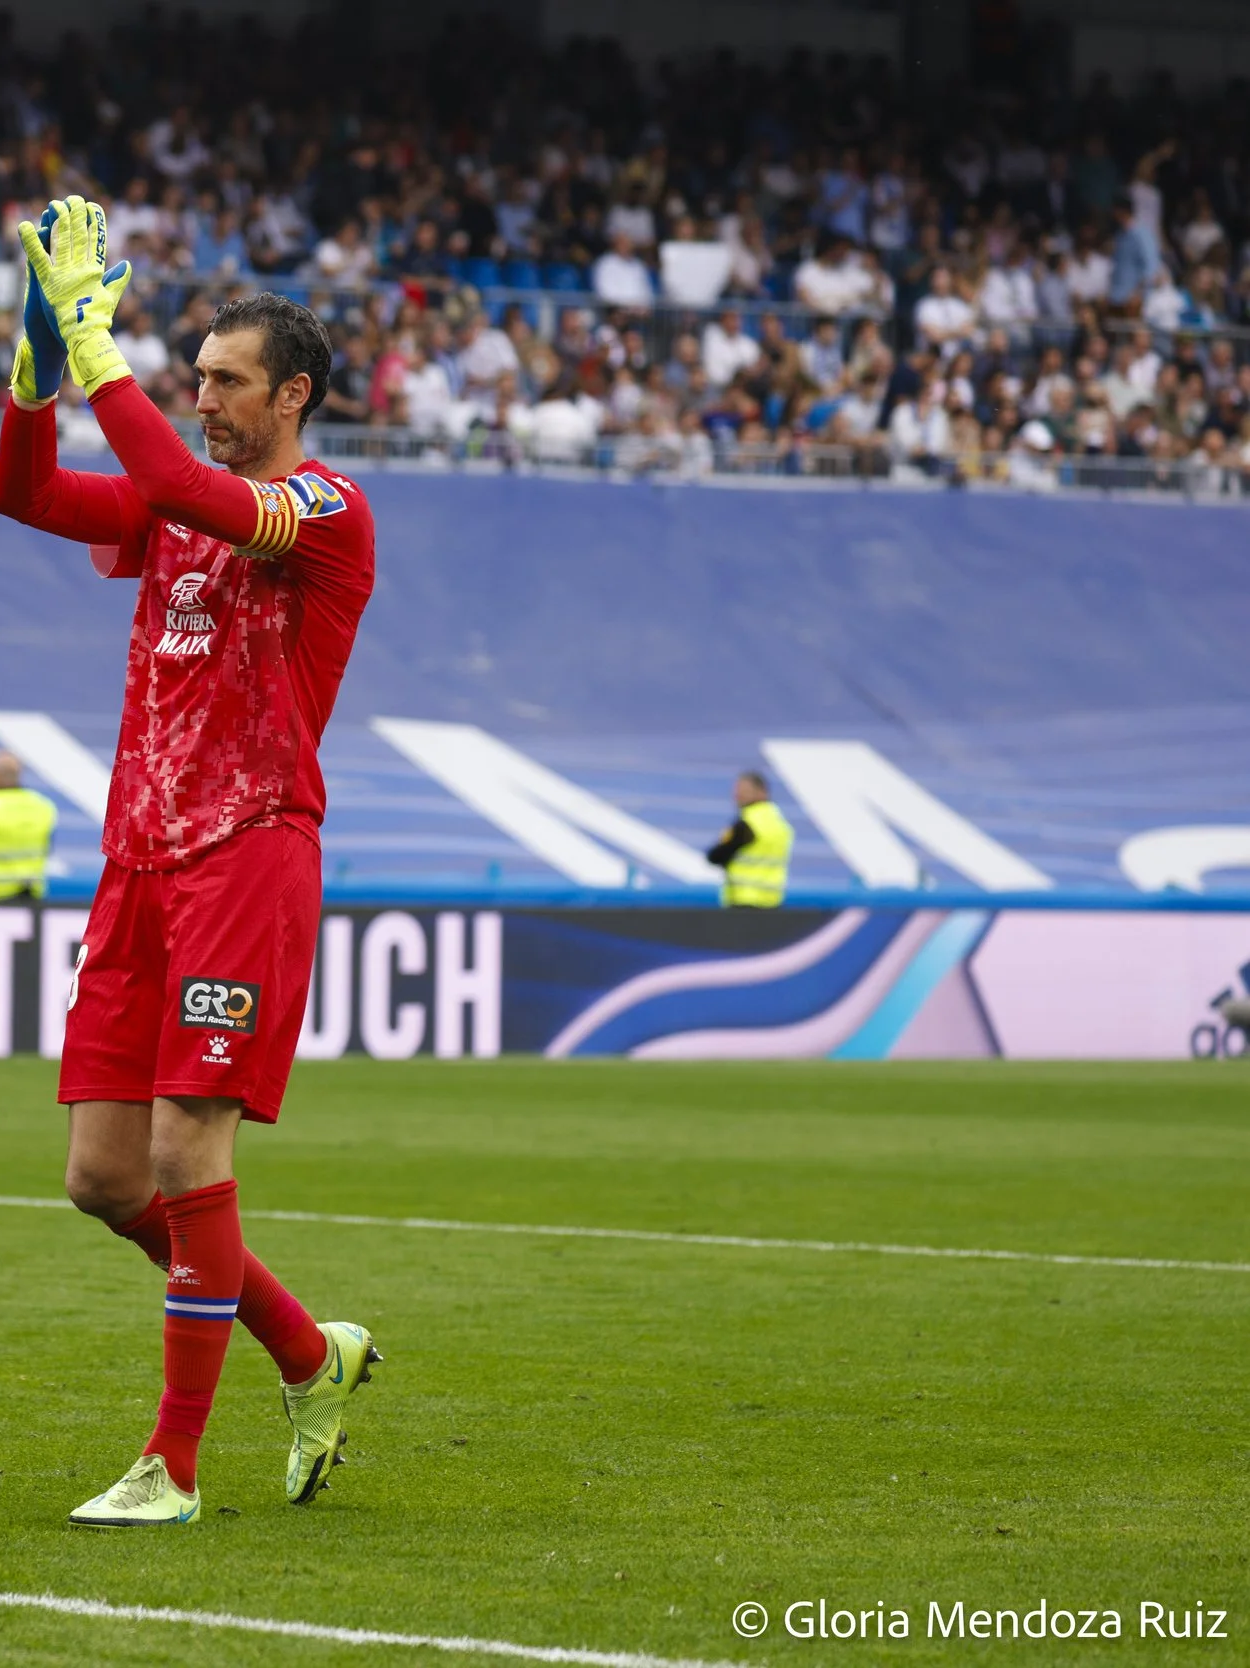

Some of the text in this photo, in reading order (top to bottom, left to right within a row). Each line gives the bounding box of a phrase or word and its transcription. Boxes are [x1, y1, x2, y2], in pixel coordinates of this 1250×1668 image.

[184, 982, 253, 1019] GRO
[184, 1014, 247, 1028] Global Racing Oil
[202, 1054, 232, 1065] KELME
